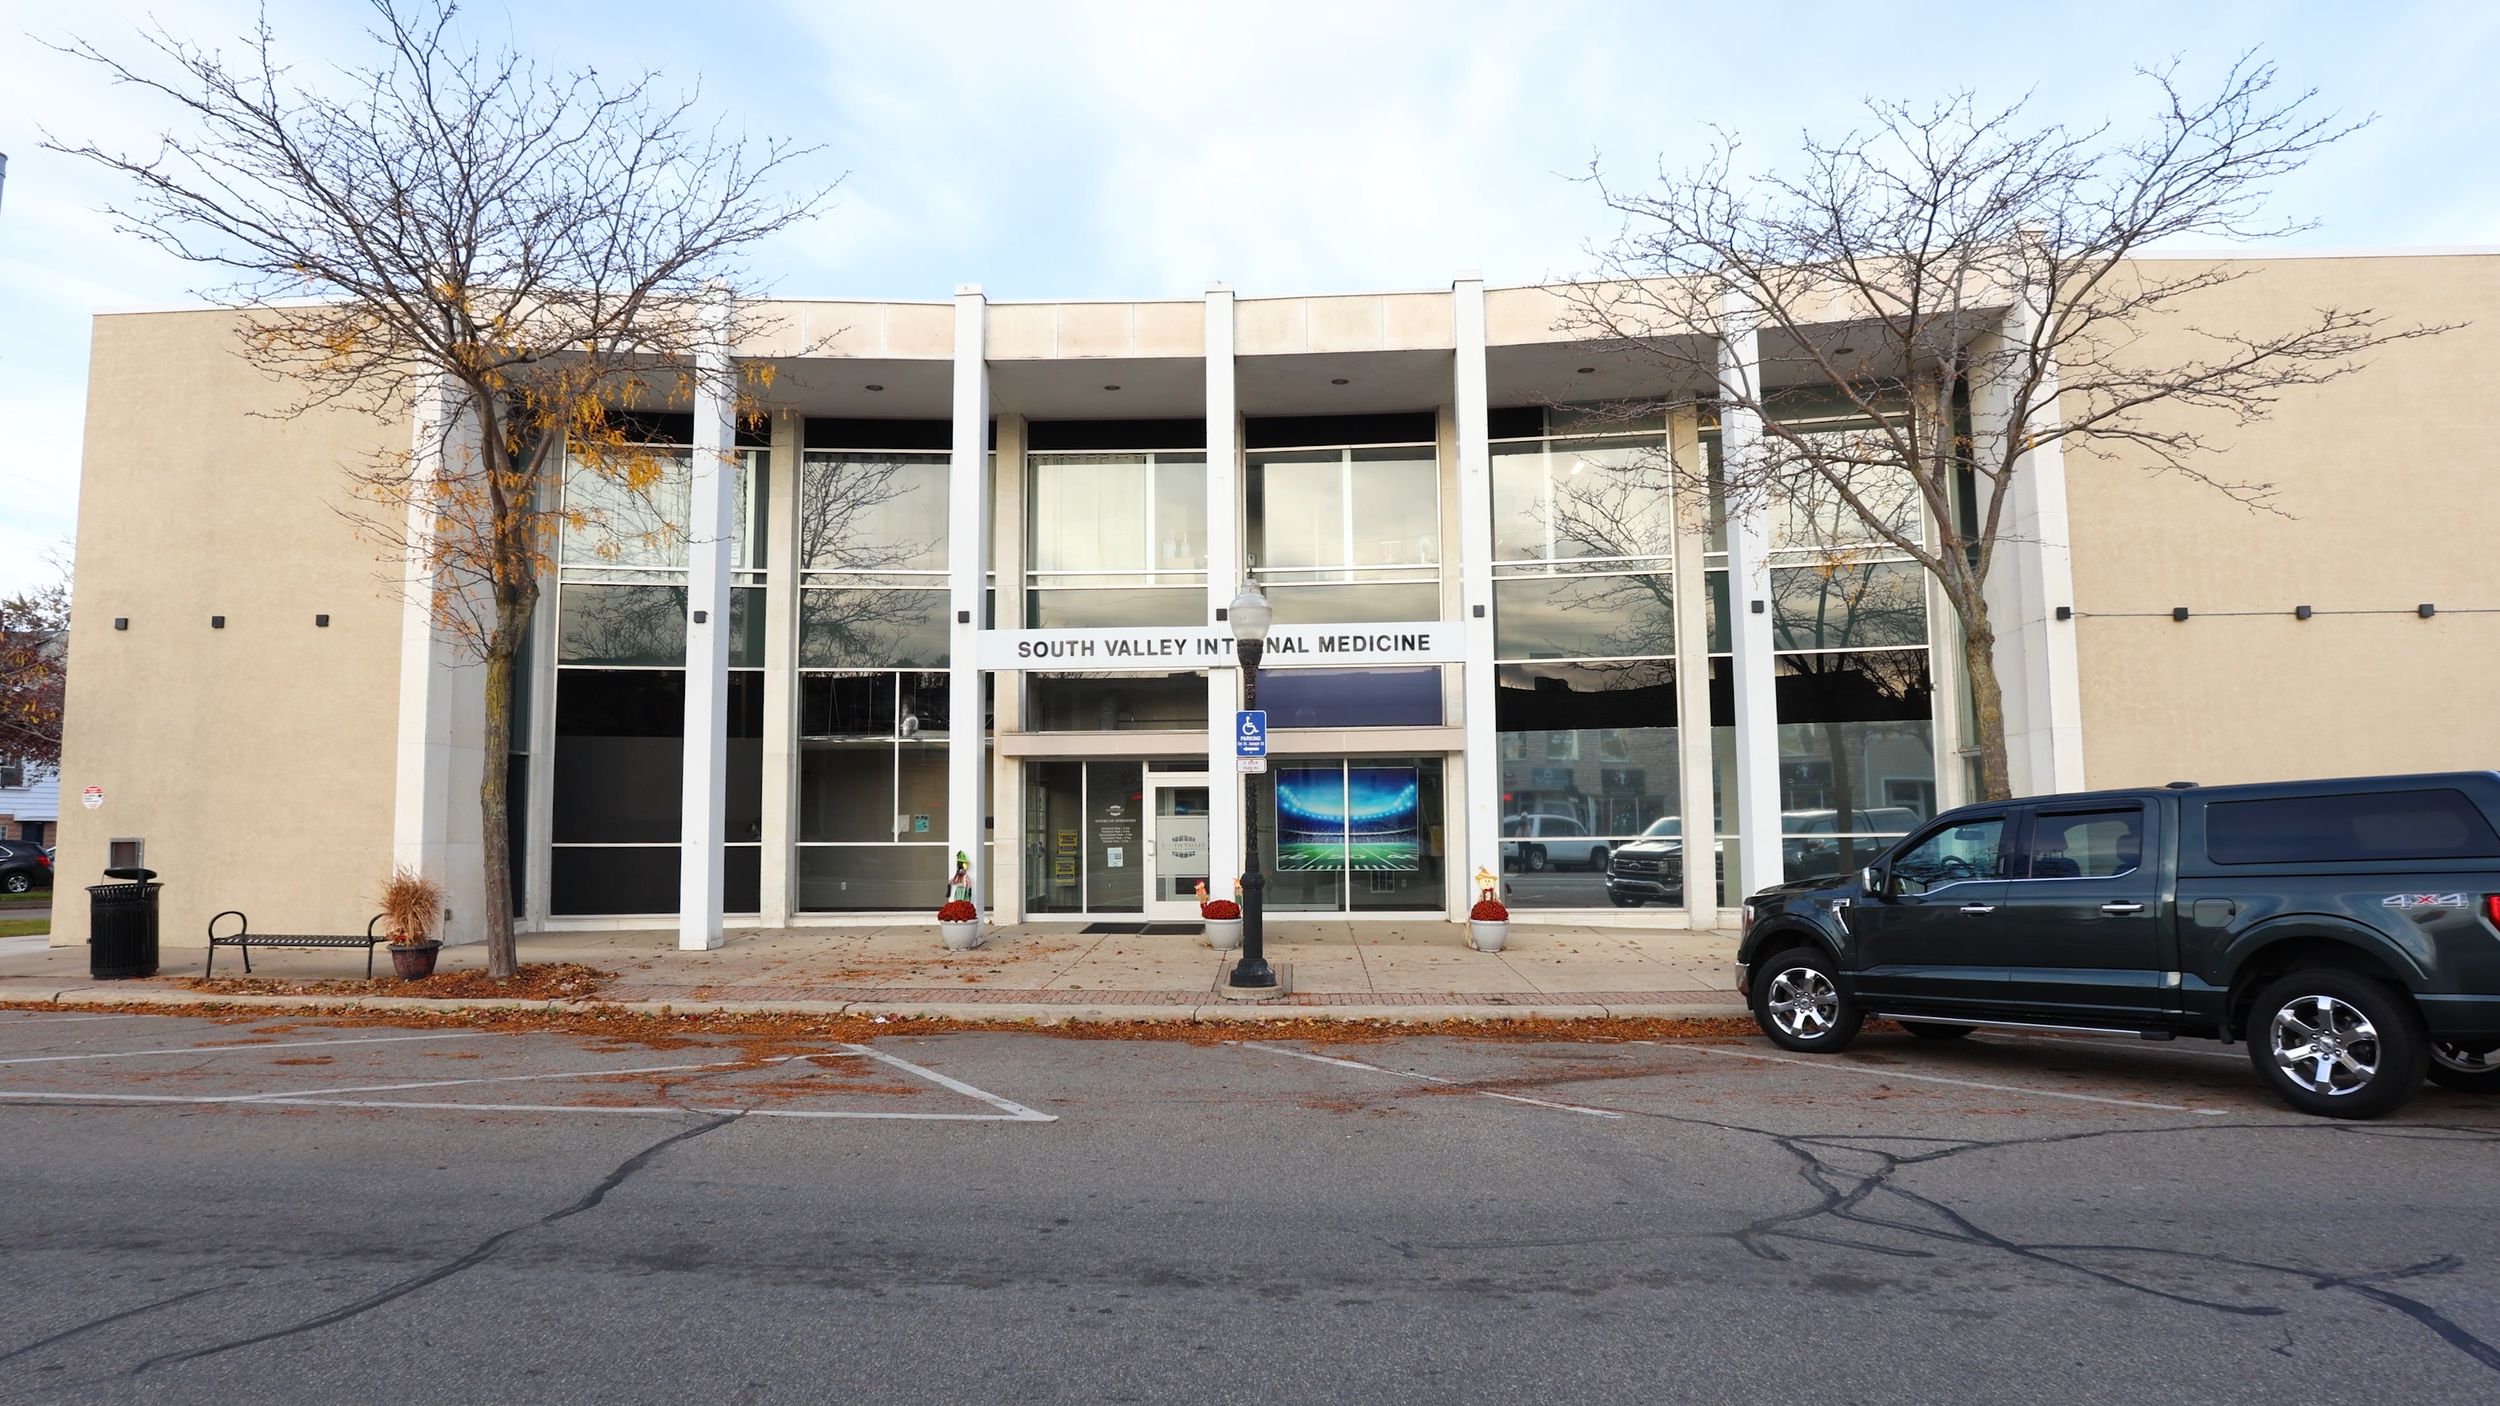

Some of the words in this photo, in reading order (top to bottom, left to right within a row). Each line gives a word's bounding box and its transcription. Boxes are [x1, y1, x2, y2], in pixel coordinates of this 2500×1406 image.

[1018, 640, 1095, 658] SOUTH
[1104, 639, 1187, 656] VALLEY
[1197, 636, 1309, 655] INTNAL
[1318, 634, 1430, 653] MEDICINE
